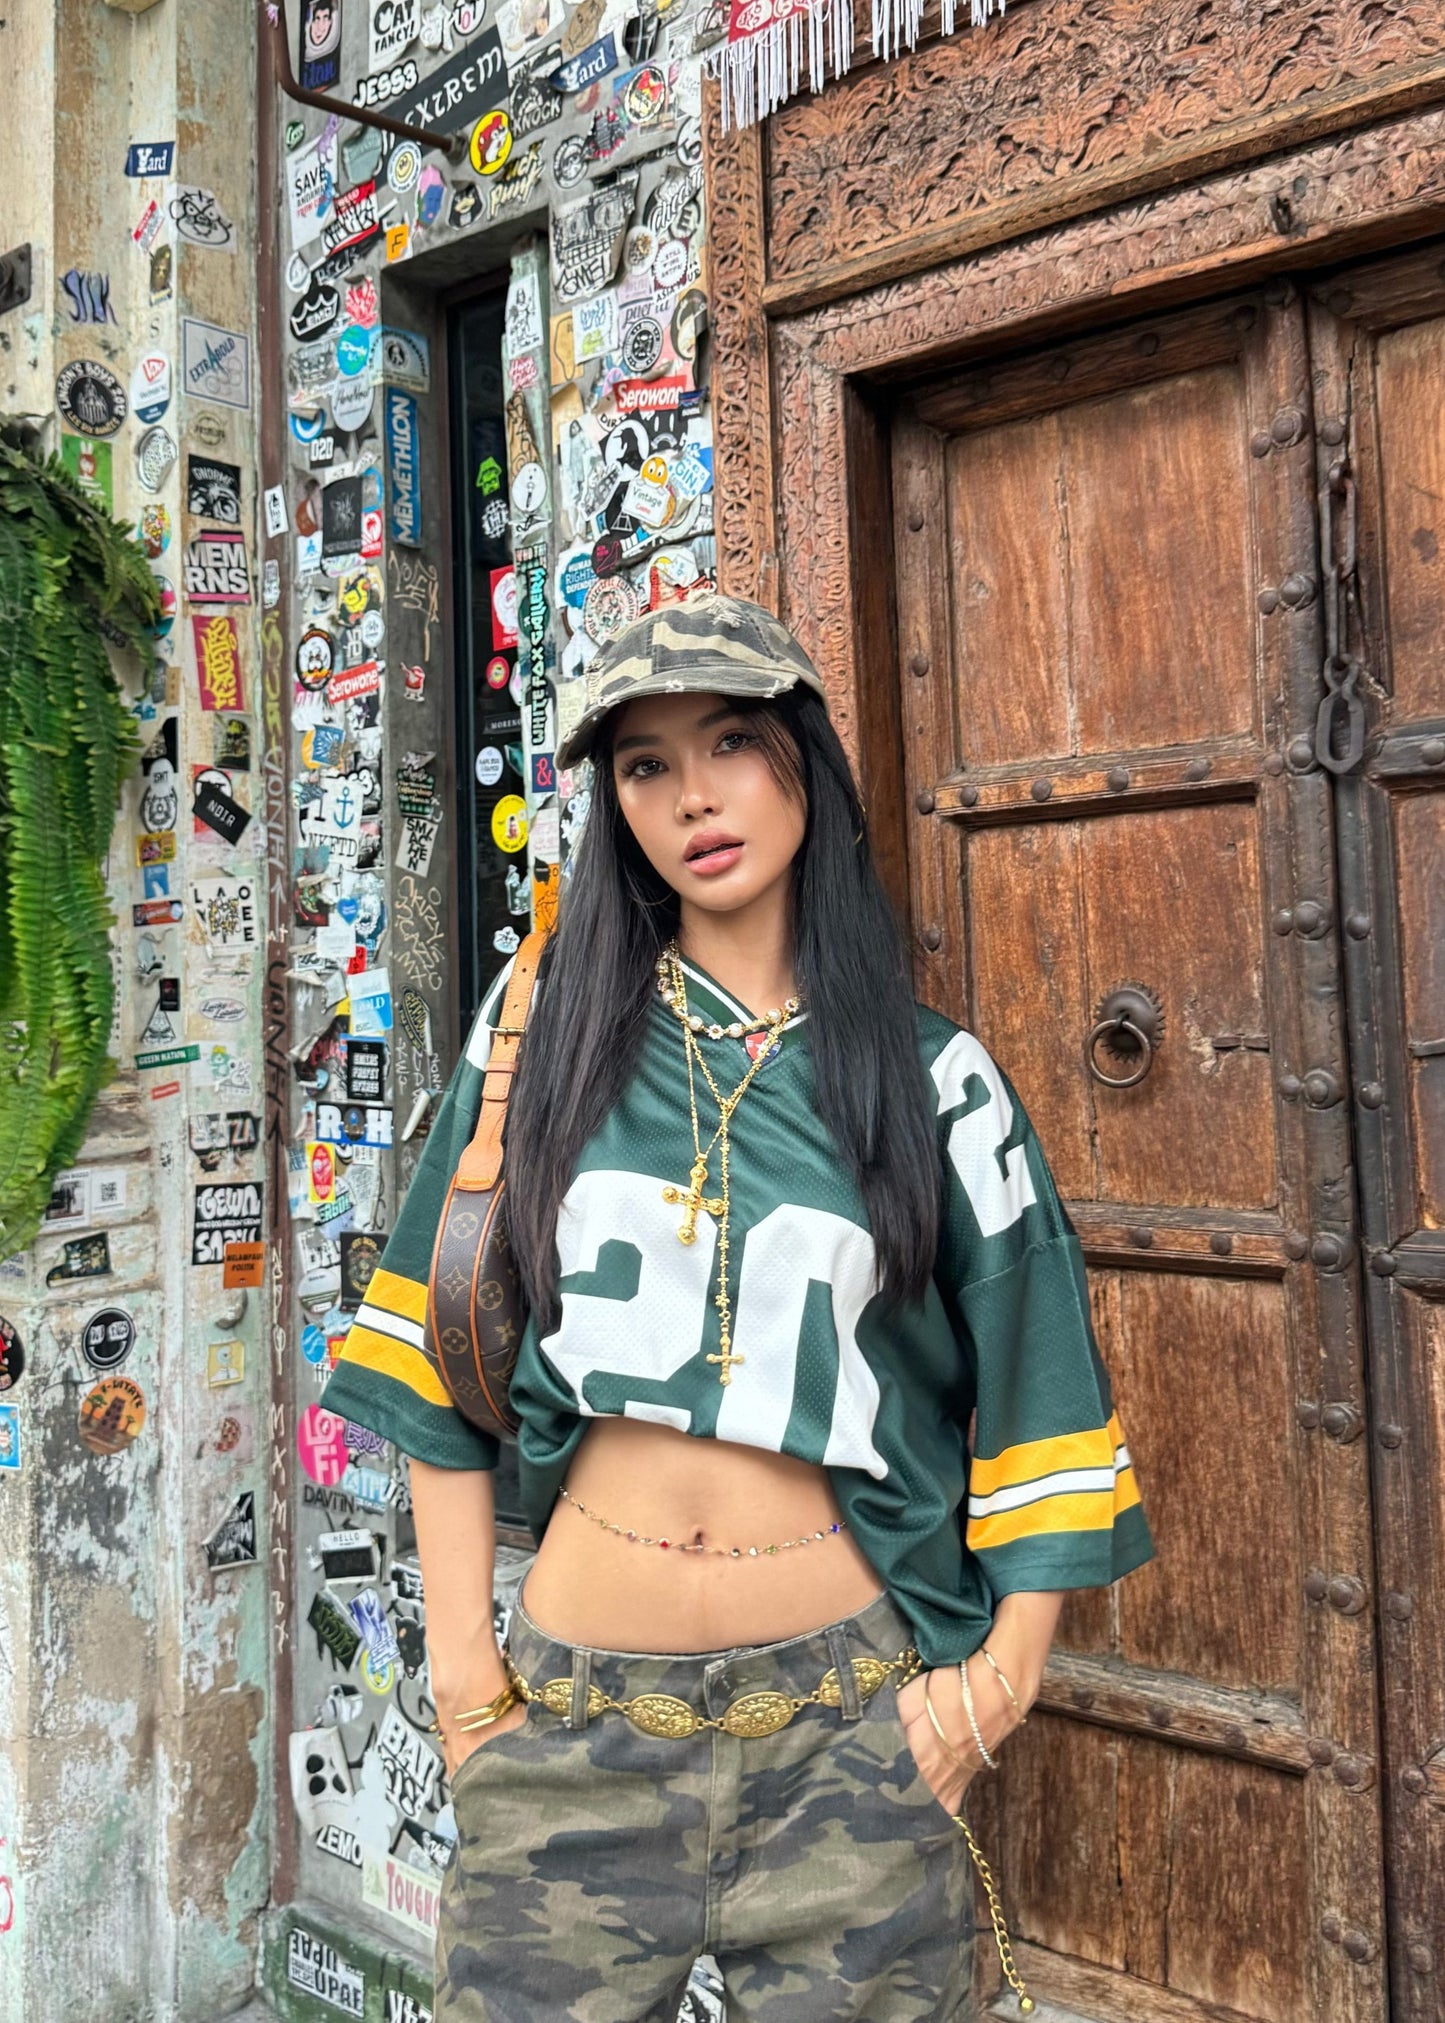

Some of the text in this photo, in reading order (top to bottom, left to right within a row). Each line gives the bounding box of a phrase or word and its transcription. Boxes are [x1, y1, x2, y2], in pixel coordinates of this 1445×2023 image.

[374, 20, 416, 54] FANCY!
[558, 47, 608, 89] Yard
[353, 63, 417, 109] JESS3
[137, 148, 168, 174] Yard
[295, 163, 326, 198] SAVE
[186, 567, 250, 594] RNS
[205, 799, 236, 827] NOIR
